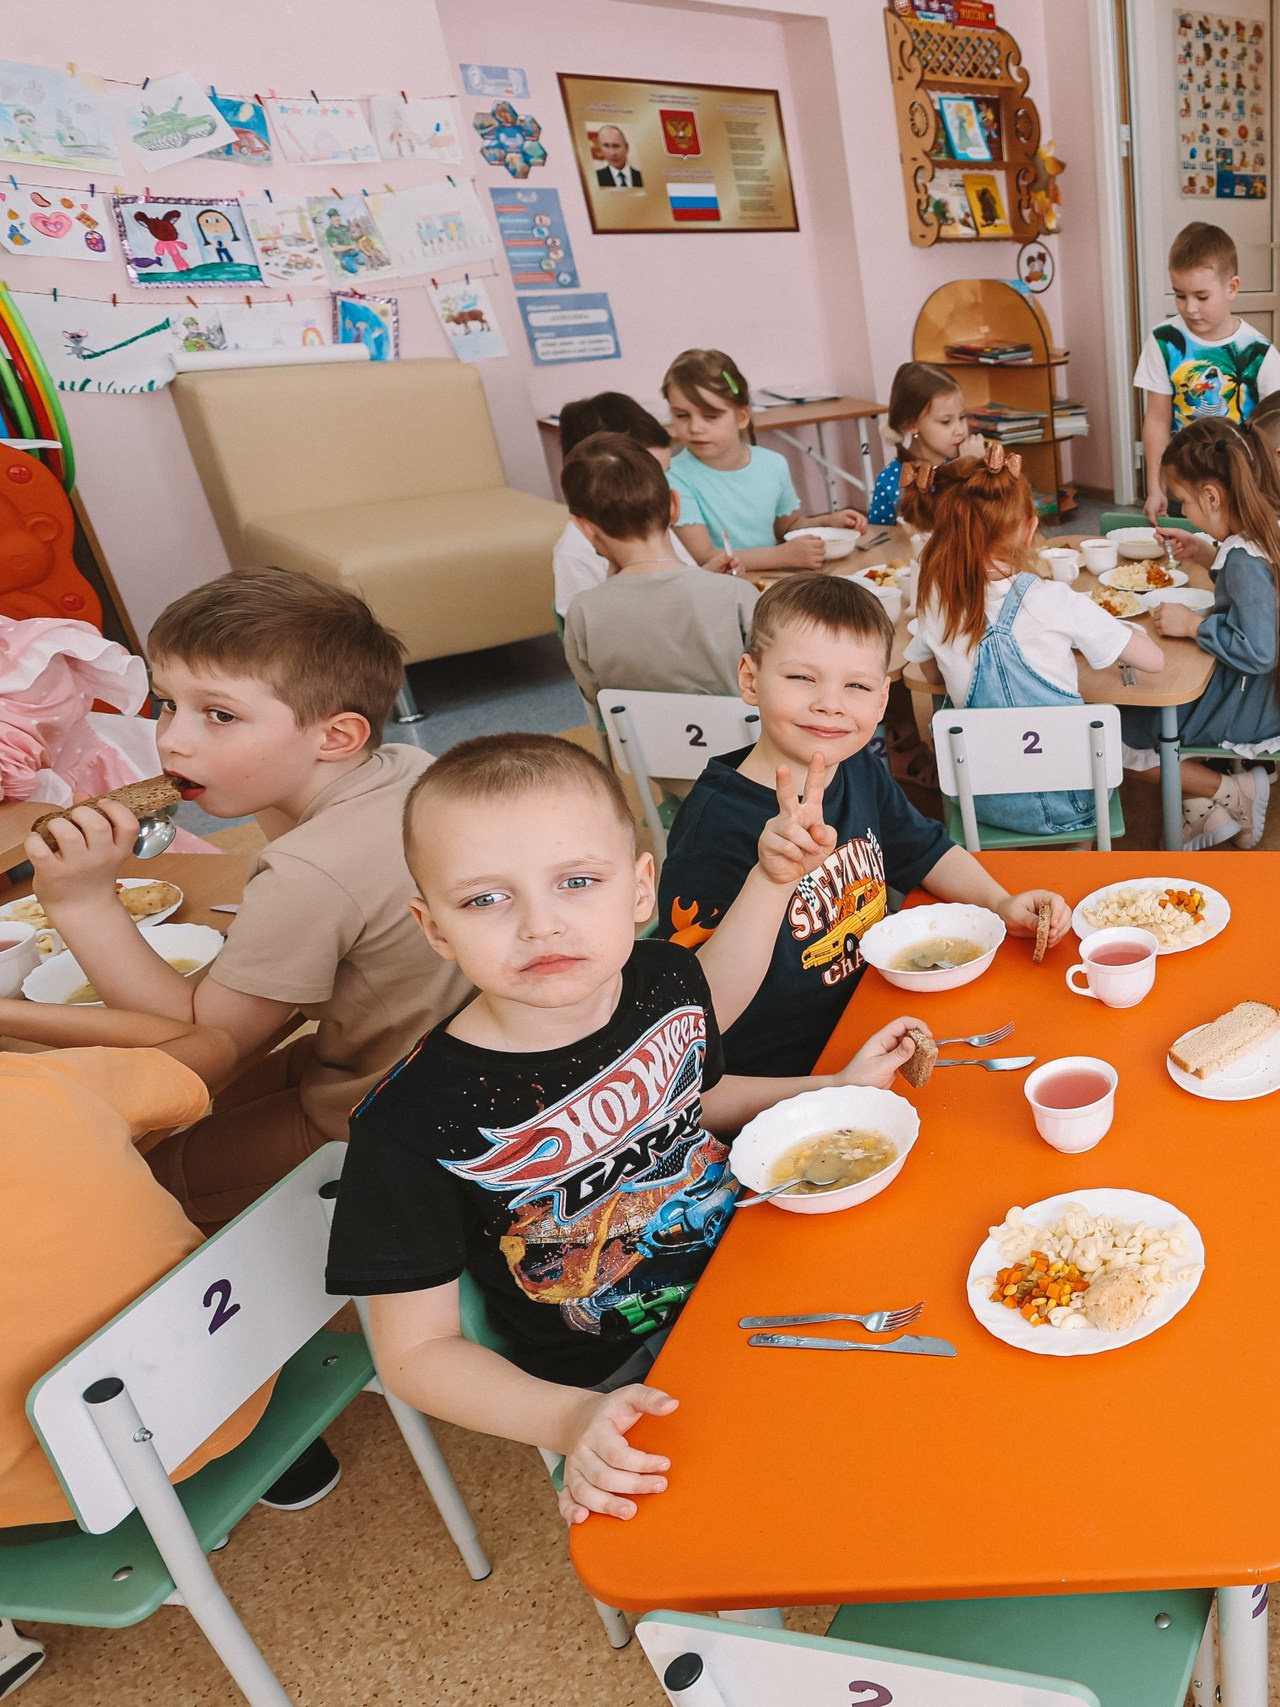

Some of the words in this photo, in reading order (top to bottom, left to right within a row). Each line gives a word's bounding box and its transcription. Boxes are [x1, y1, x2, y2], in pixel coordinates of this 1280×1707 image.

[861, 442, 870, 455] 2
[685, 723, 708, 747] 2
[870, 736, 887, 757] 2
[1021, 730, 1043, 755] 2
[550, 1077, 642, 1166] HOT
[202, 1278, 241, 1336] 2
